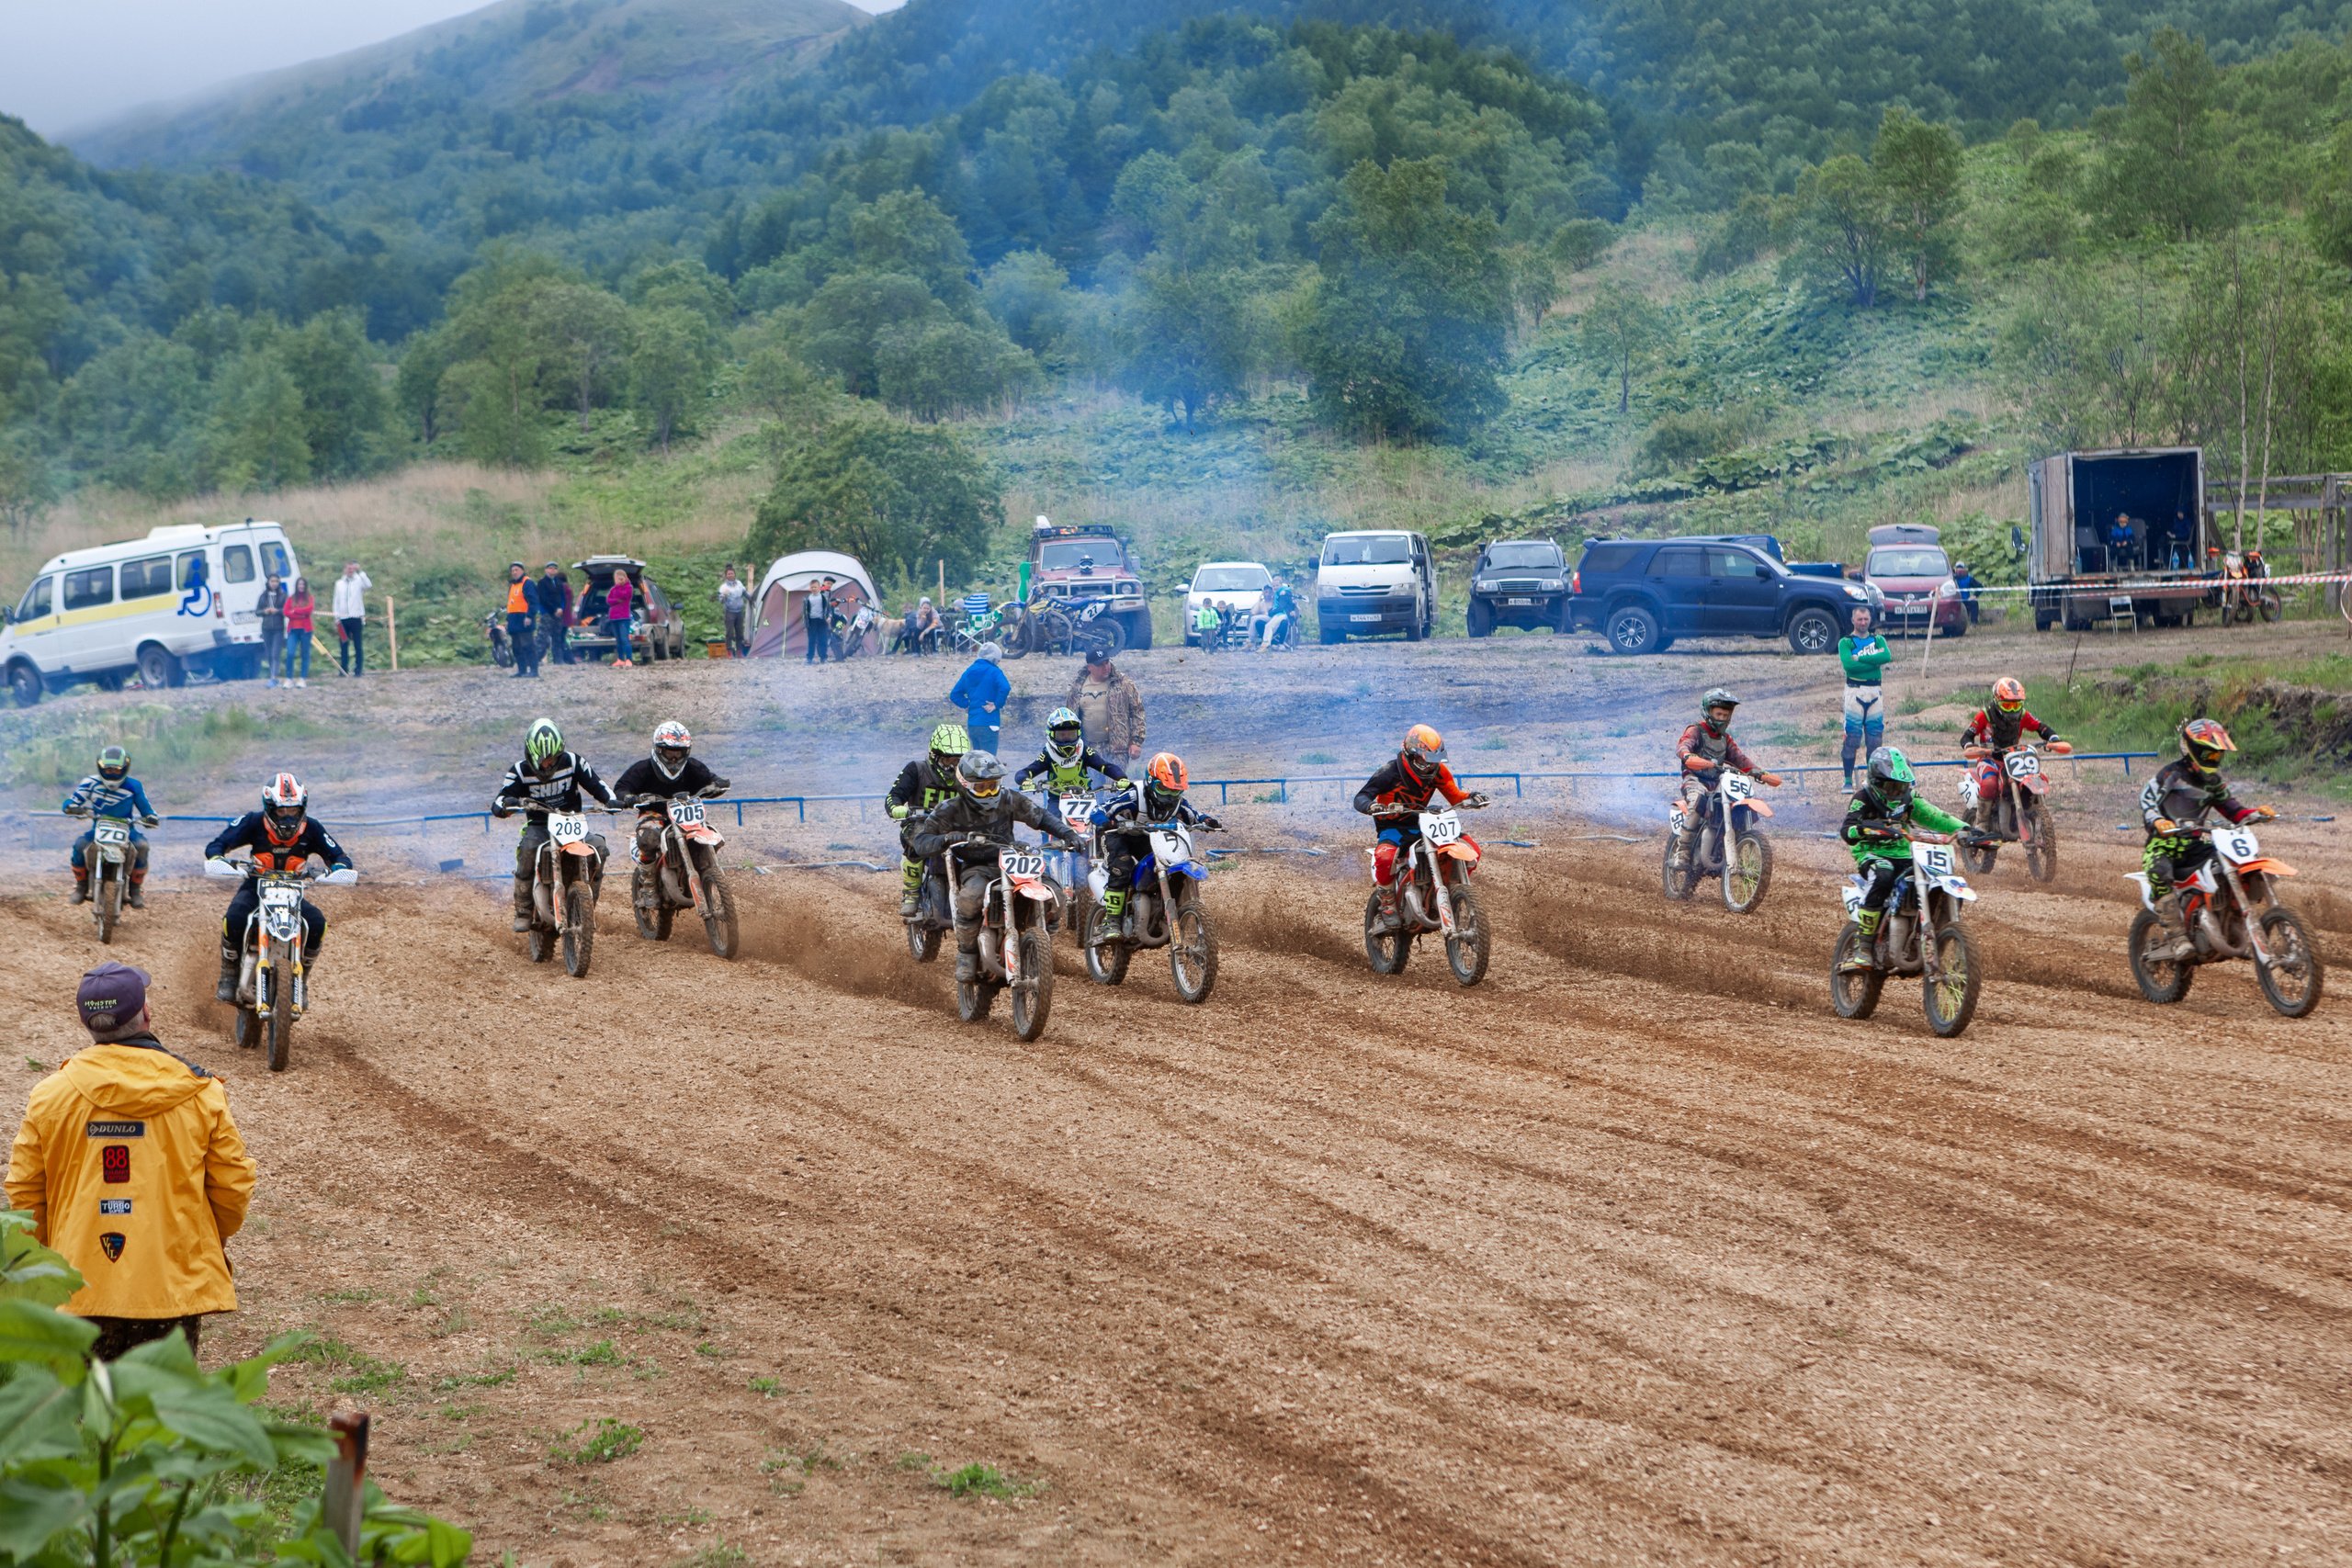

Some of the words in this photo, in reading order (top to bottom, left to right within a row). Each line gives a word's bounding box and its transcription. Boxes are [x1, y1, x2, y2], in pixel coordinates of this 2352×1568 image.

[1087, 605, 1097, 617] 27
[2009, 756, 2040, 775] 29
[1730, 779, 1748, 795] 56
[673, 805, 705, 824] 205
[1067, 801, 1092, 816] 77
[99, 829, 126, 841] 70
[555, 821, 582, 837] 208
[1429, 821, 1455, 839] 207
[2232, 838, 2251, 857] 6
[1005, 857, 1042, 874] 202
[1927, 851, 1947, 866] 15
[98, 1124, 137, 1134] DUNLO
[106, 1147, 128, 1169] 88
[101, 1202, 130, 1211] TURBO
